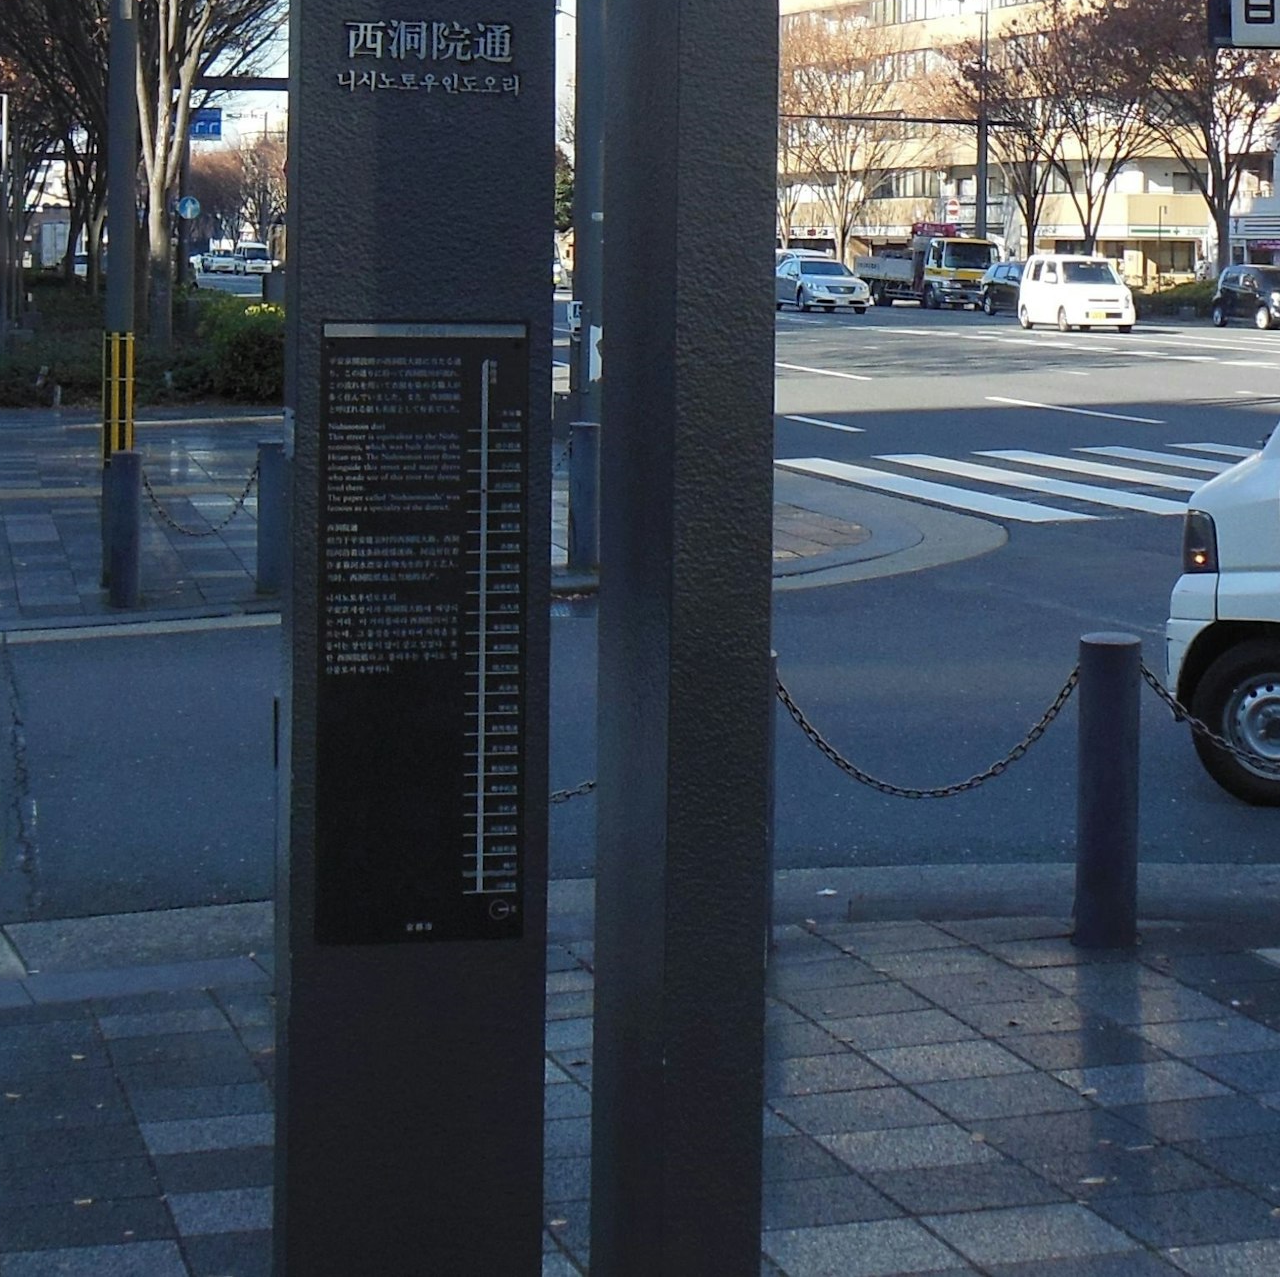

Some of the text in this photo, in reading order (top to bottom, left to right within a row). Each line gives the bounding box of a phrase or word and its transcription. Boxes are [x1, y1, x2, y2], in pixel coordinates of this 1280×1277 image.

[345, 19, 514, 63] 西洞院通
[336, 69, 521, 96] 니시노토우인도오리
